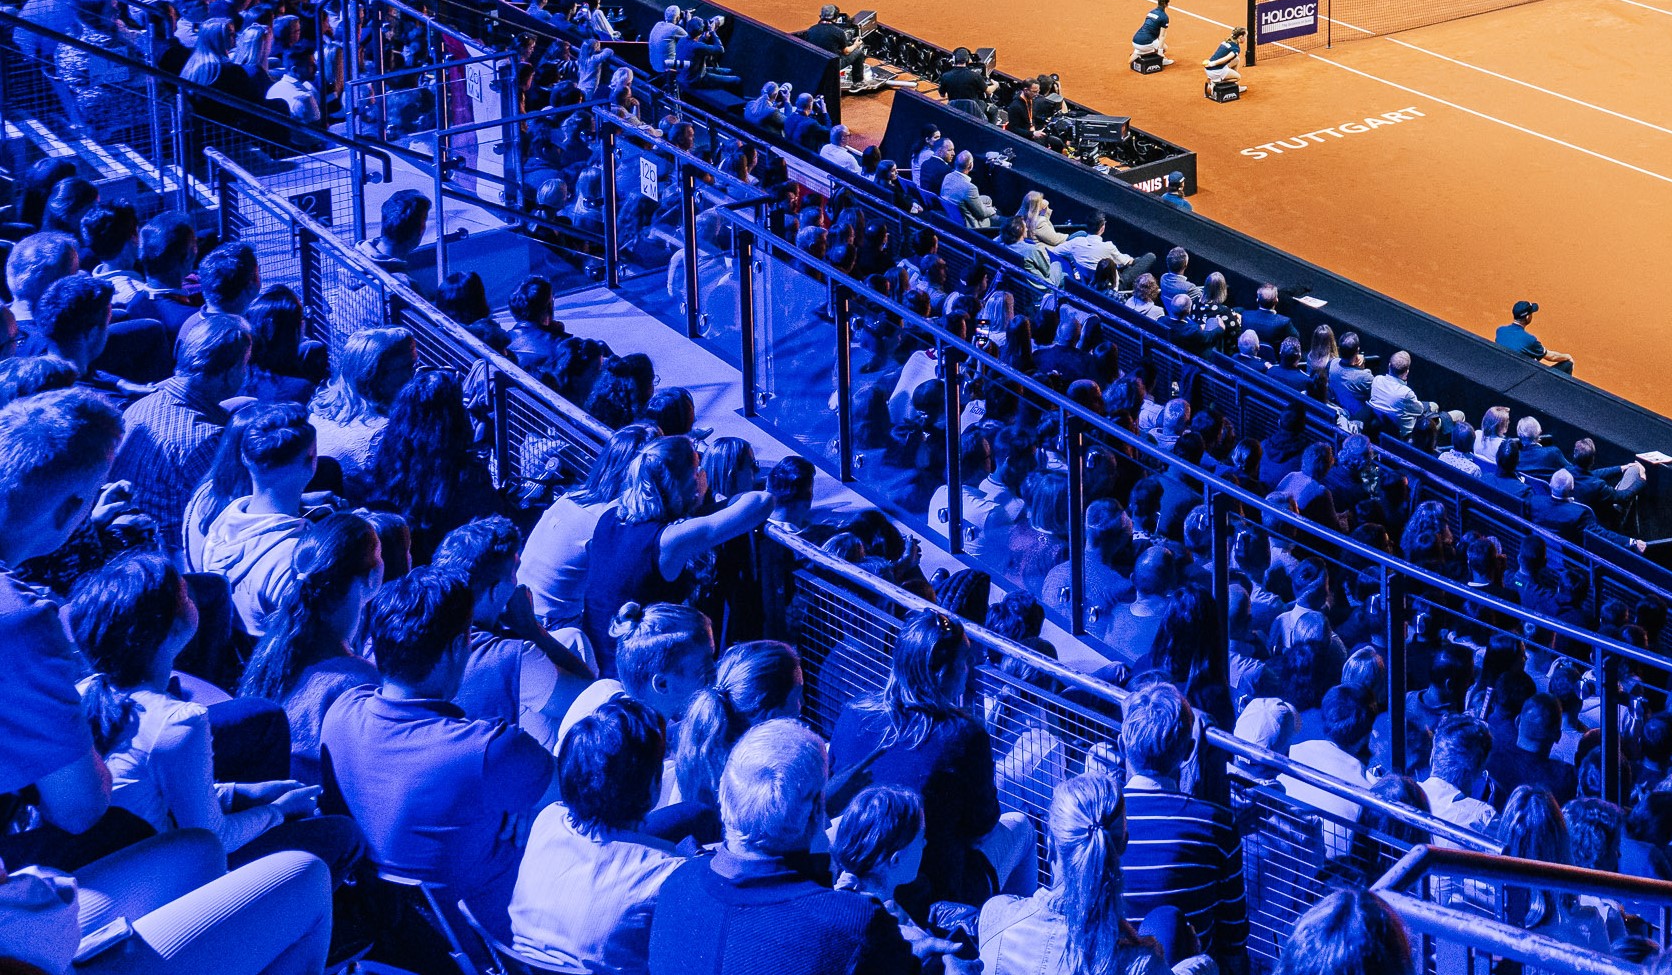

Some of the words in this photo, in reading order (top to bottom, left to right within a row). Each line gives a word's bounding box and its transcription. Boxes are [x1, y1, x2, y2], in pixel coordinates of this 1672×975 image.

[1262, 3, 1316, 25] HOLOGIC
[1240, 106, 1426, 160] STUTTGART
[1135, 177, 1162, 194] NNIS
